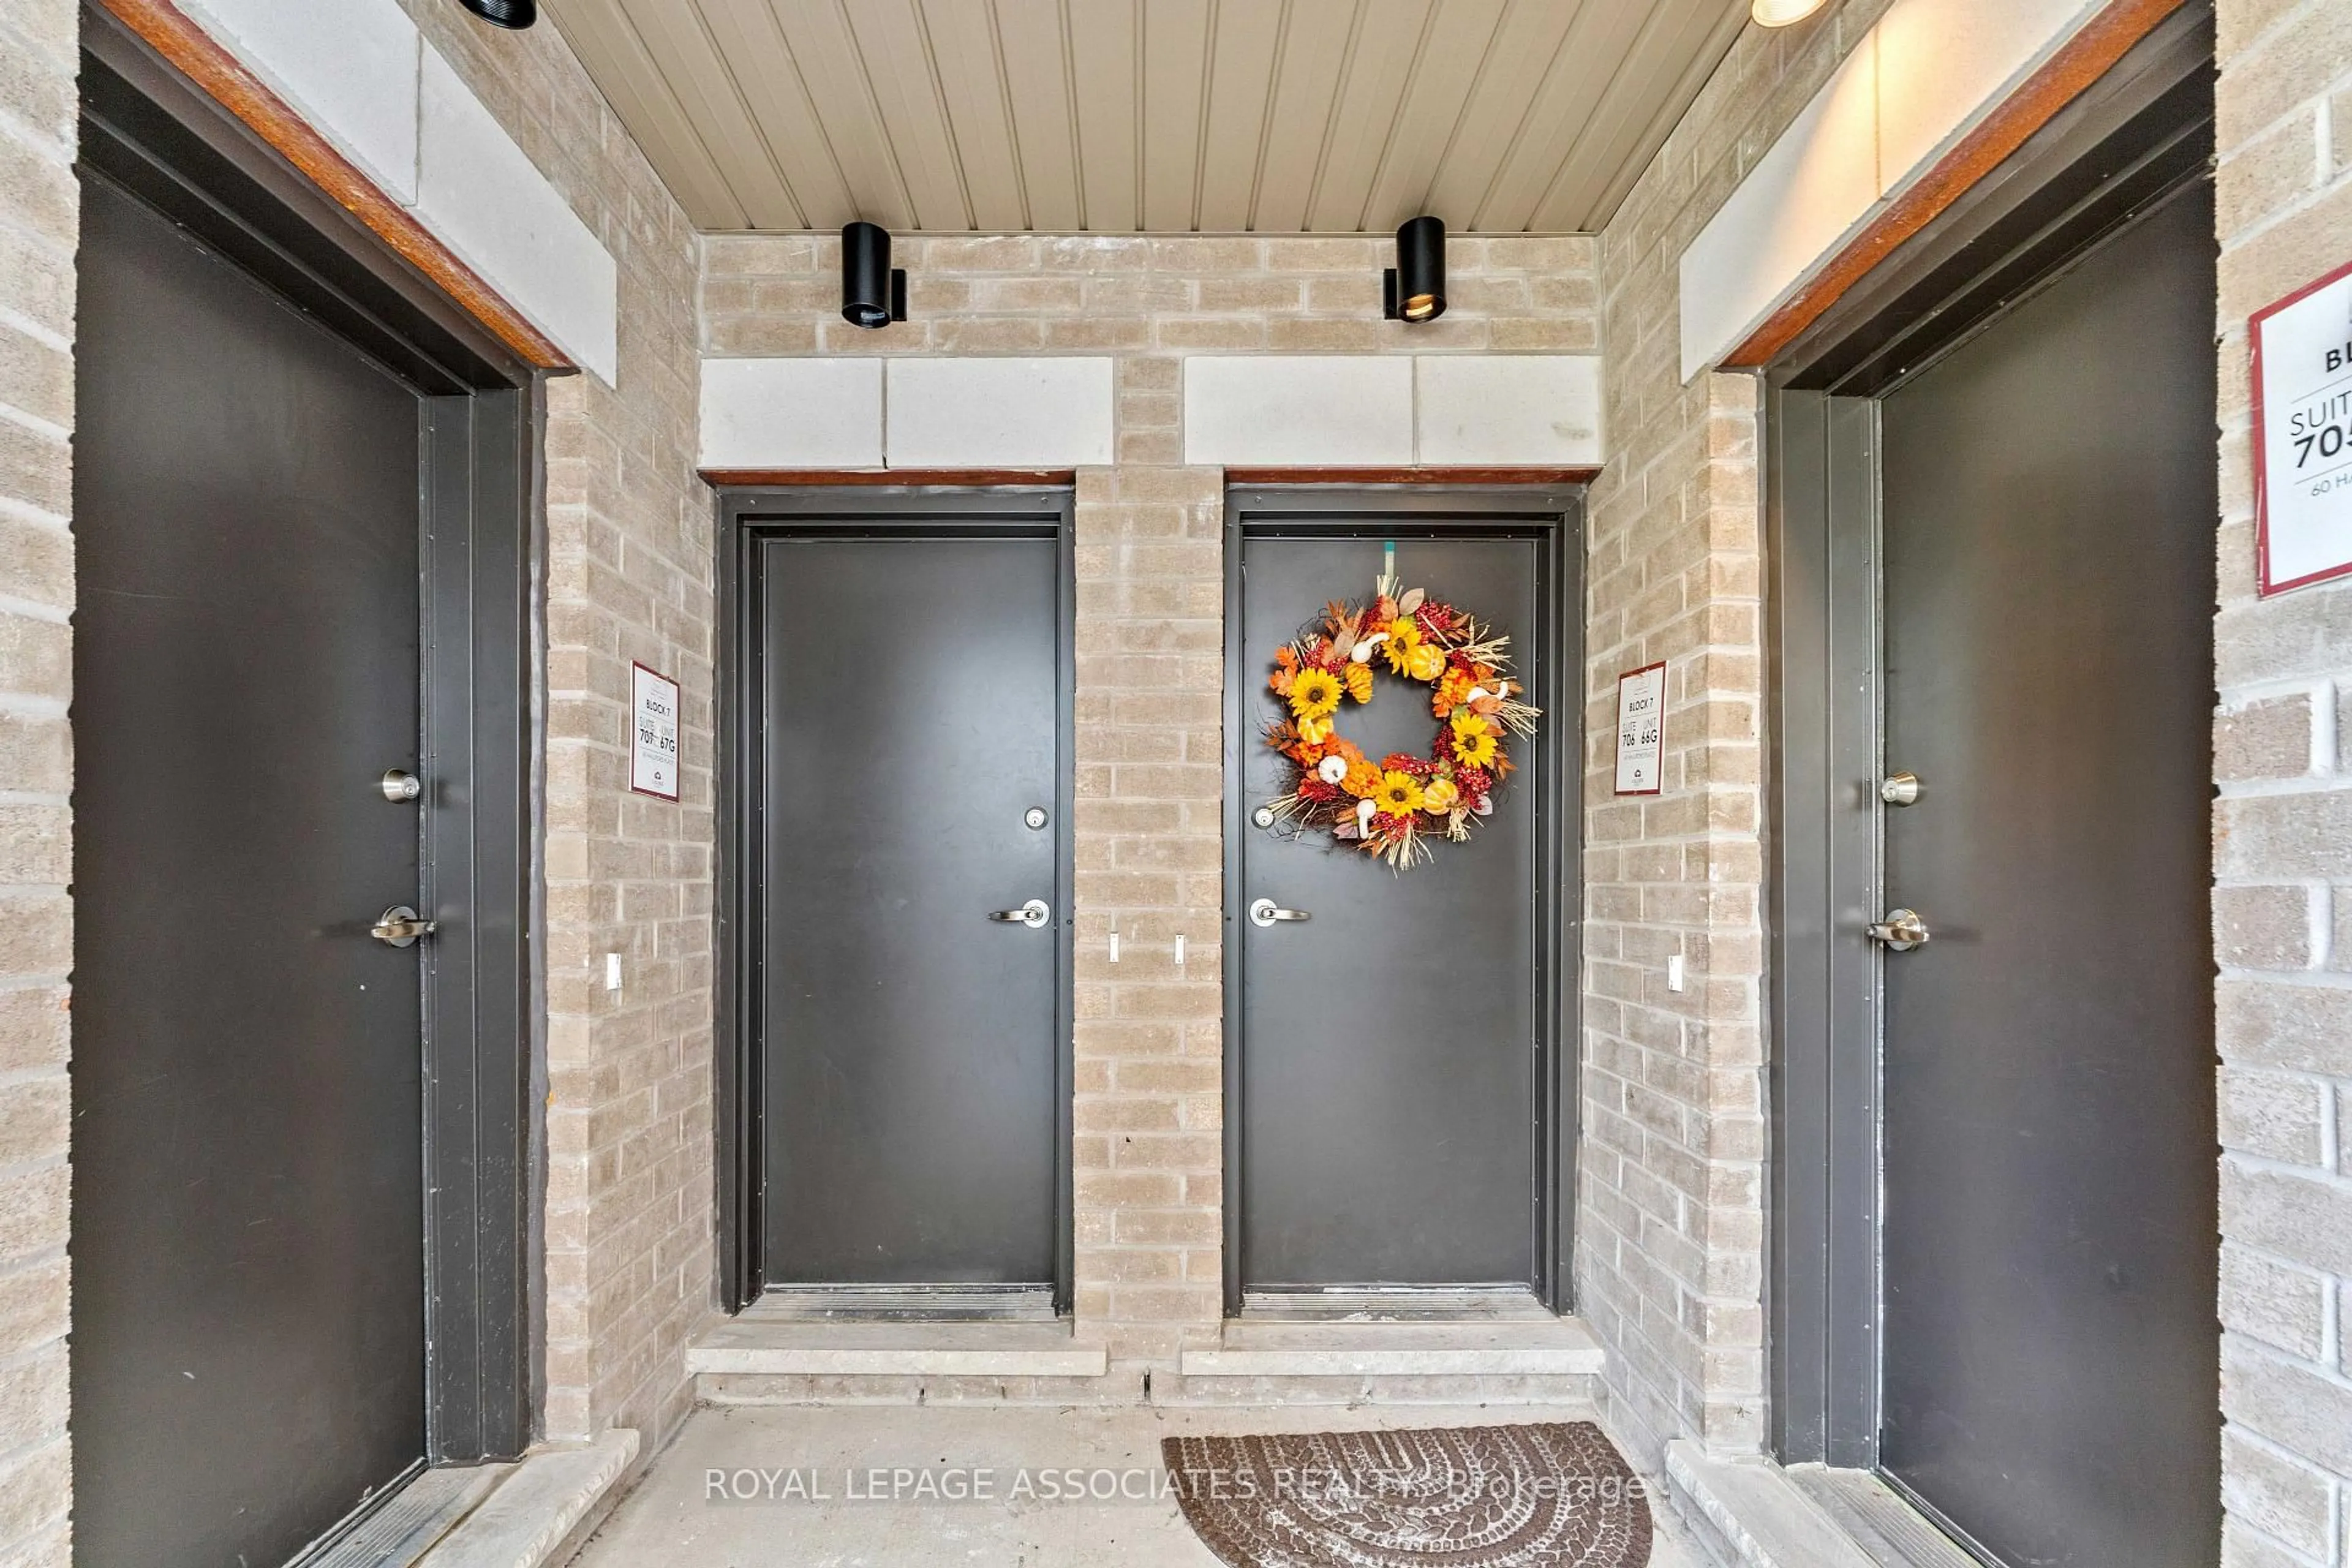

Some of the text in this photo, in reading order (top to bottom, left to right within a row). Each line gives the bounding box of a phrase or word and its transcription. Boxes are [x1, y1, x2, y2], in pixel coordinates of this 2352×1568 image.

[2294, 419, 2352, 468] 70
[2311, 480, 2331, 497] 60
[646, 699, 671, 716] BLOCK 7
[1629, 697, 1654, 712] BLOCK 7
[660, 736, 675, 752] 67G
[1623, 729, 1657, 747] 706 66G
